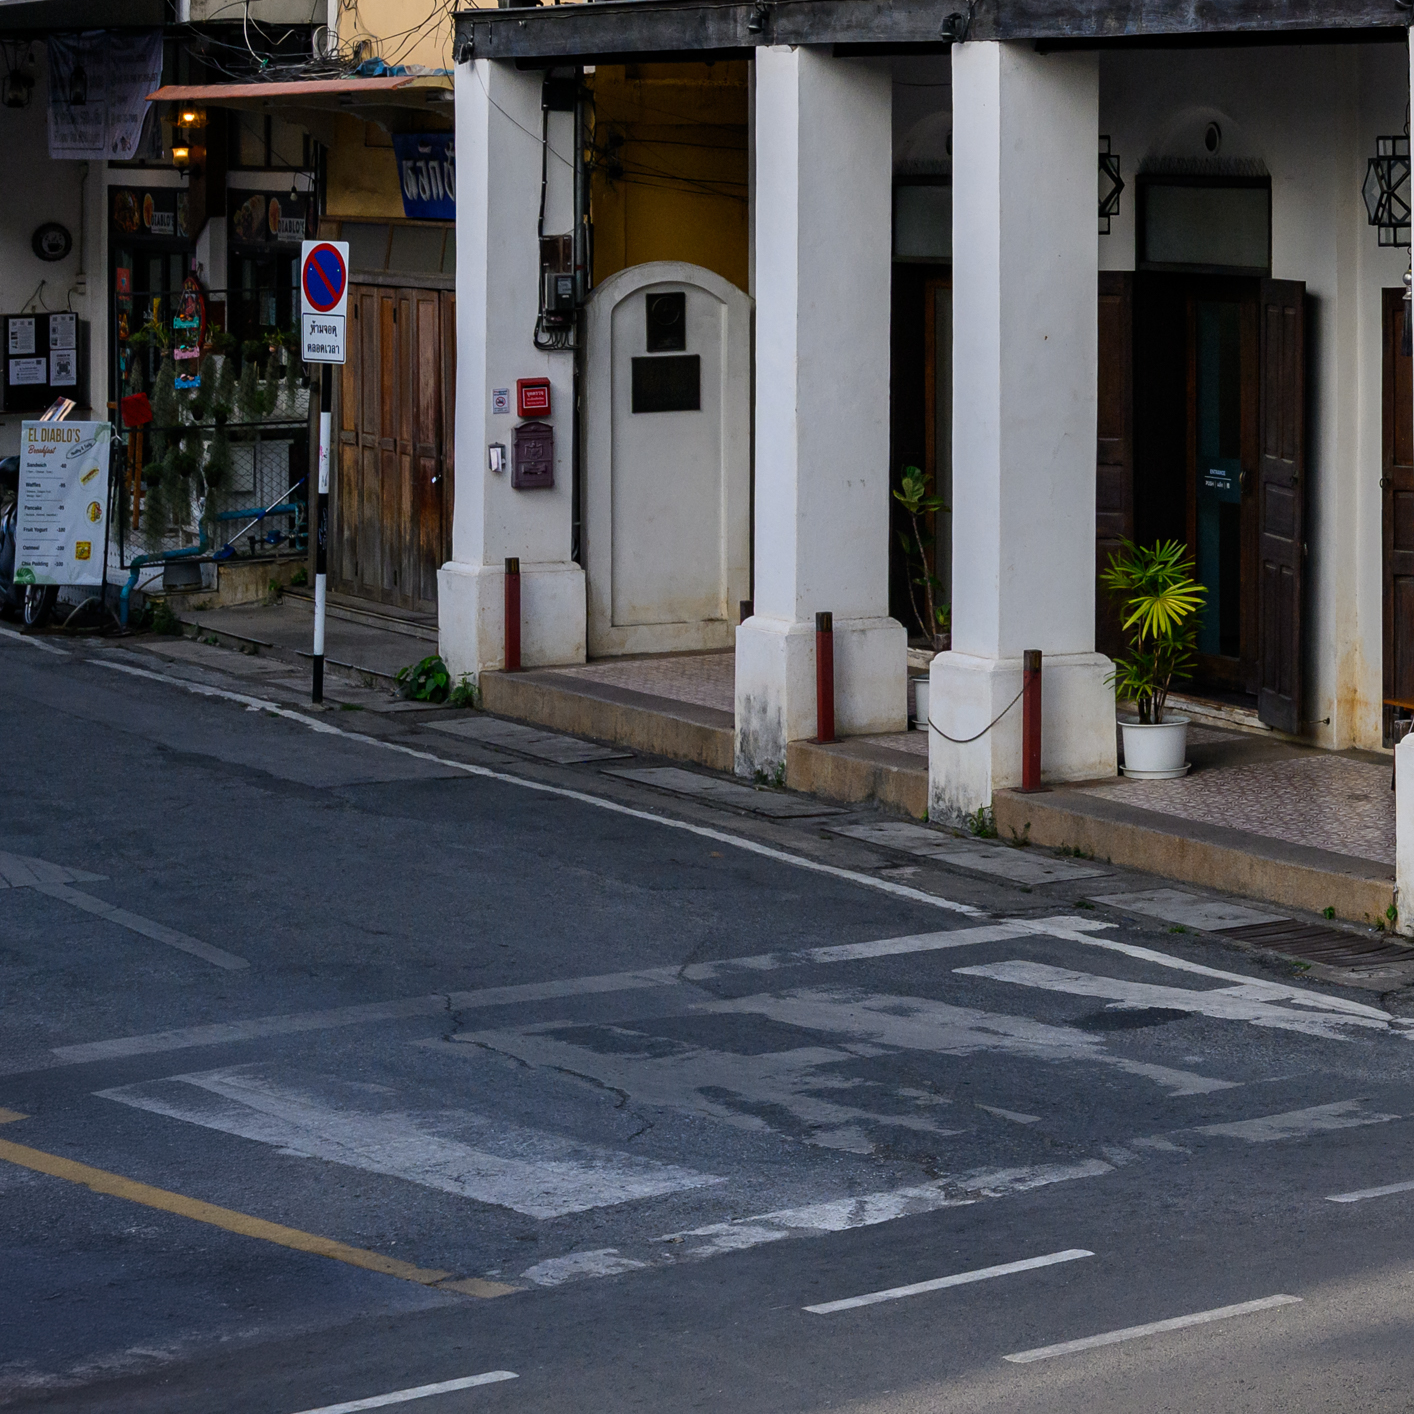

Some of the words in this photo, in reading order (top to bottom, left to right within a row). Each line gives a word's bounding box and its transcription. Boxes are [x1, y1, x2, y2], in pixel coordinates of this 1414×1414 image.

[307, 343, 340, 354] ตลอดเวลา
[28, 427, 39, 443] EL
[41, 427, 81, 443] DIABLO'S
[27, 444, 57, 458] Breakfast
